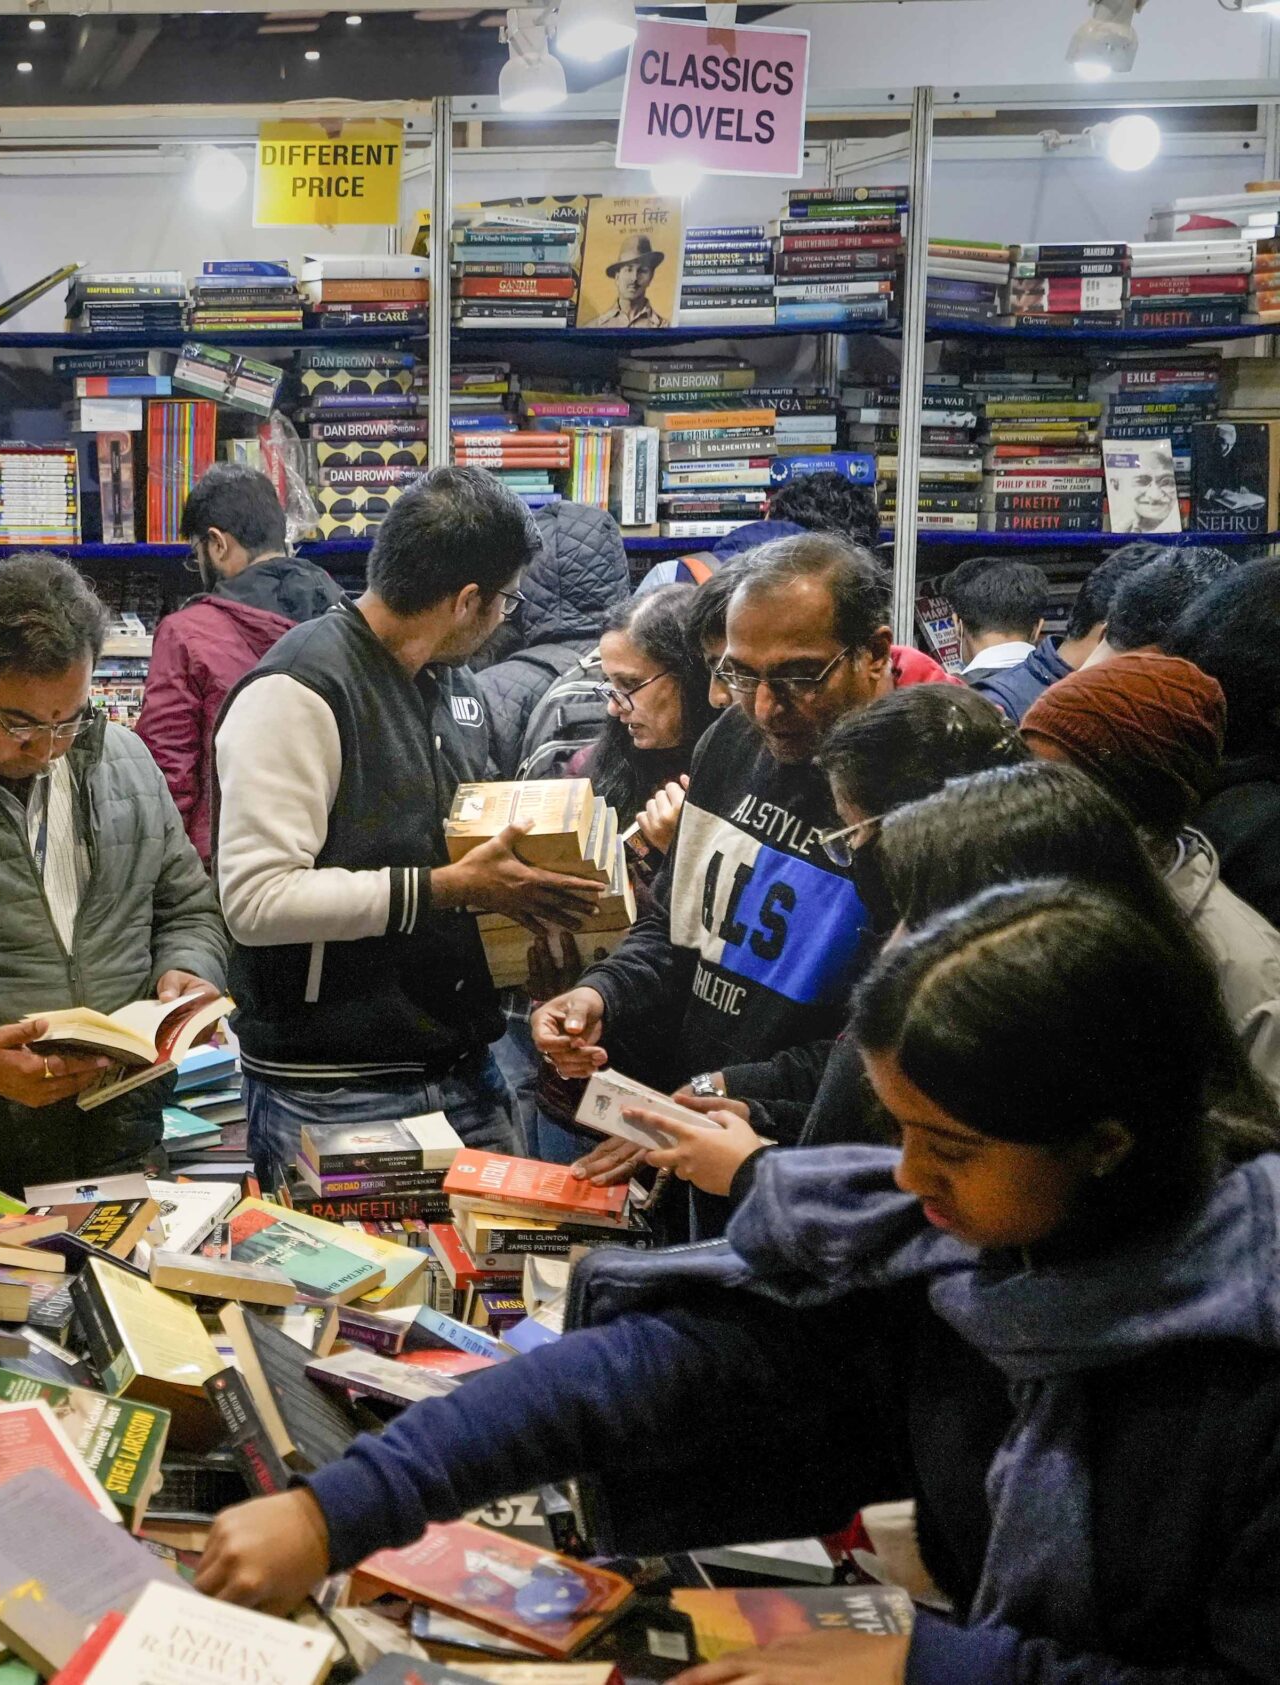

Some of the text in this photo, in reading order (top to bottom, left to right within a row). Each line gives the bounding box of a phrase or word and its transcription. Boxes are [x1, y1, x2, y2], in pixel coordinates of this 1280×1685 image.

[639, 50, 795, 96] CLASSICS
[647, 102, 776, 145] NOVELS
[261, 144, 396, 167] DIFFERENT
[291, 176, 365, 198] PRICE
[499, 280, 537, 289] GANDHI
[805, 285, 850, 294] AFTERMATH
[1142, 312, 1192, 325] PIKETTY
[311, 356, 376, 367] DAN BROWN
[659, 374, 719, 387] DAN BROWN
[1127, 372, 1156, 384] EXILE
[660, 393, 698, 401] SIKKIM
[943, 398, 965, 406] WAR
[567, 406, 594, 414] CLOCK
[451, 418, 479, 426] Vietnam
[323, 426, 347, 437] DAN
[348, 424, 388, 436] BROWN
[671, 431, 686, 442] SPY
[464, 437, 502, 446] REORG
[707, 443, 761, 452] SOLZHENITSYN
[330, 470, 395, 482] DAN BROWN
[996, 480, 1023, 489] PHILIP
[1025, 479, 1048, 488] KERR
[1012, 497, 1060, 509] PIKETTY
[1012, 516, 1060, 529] PIKETTY
[1196, 516, 1260, 531] NEHRU
[327, 1184, 343, 1192] RICH
[344, 1181, 360, 1190] DAD
[312, 1202, 396, 1217] RAJNEETI
[342, 1264, 375, 1286] CHETAN
[102, 1403, 122, 1430] Nest
[104, 1410, 156, 1495] STIEG LARSSON
